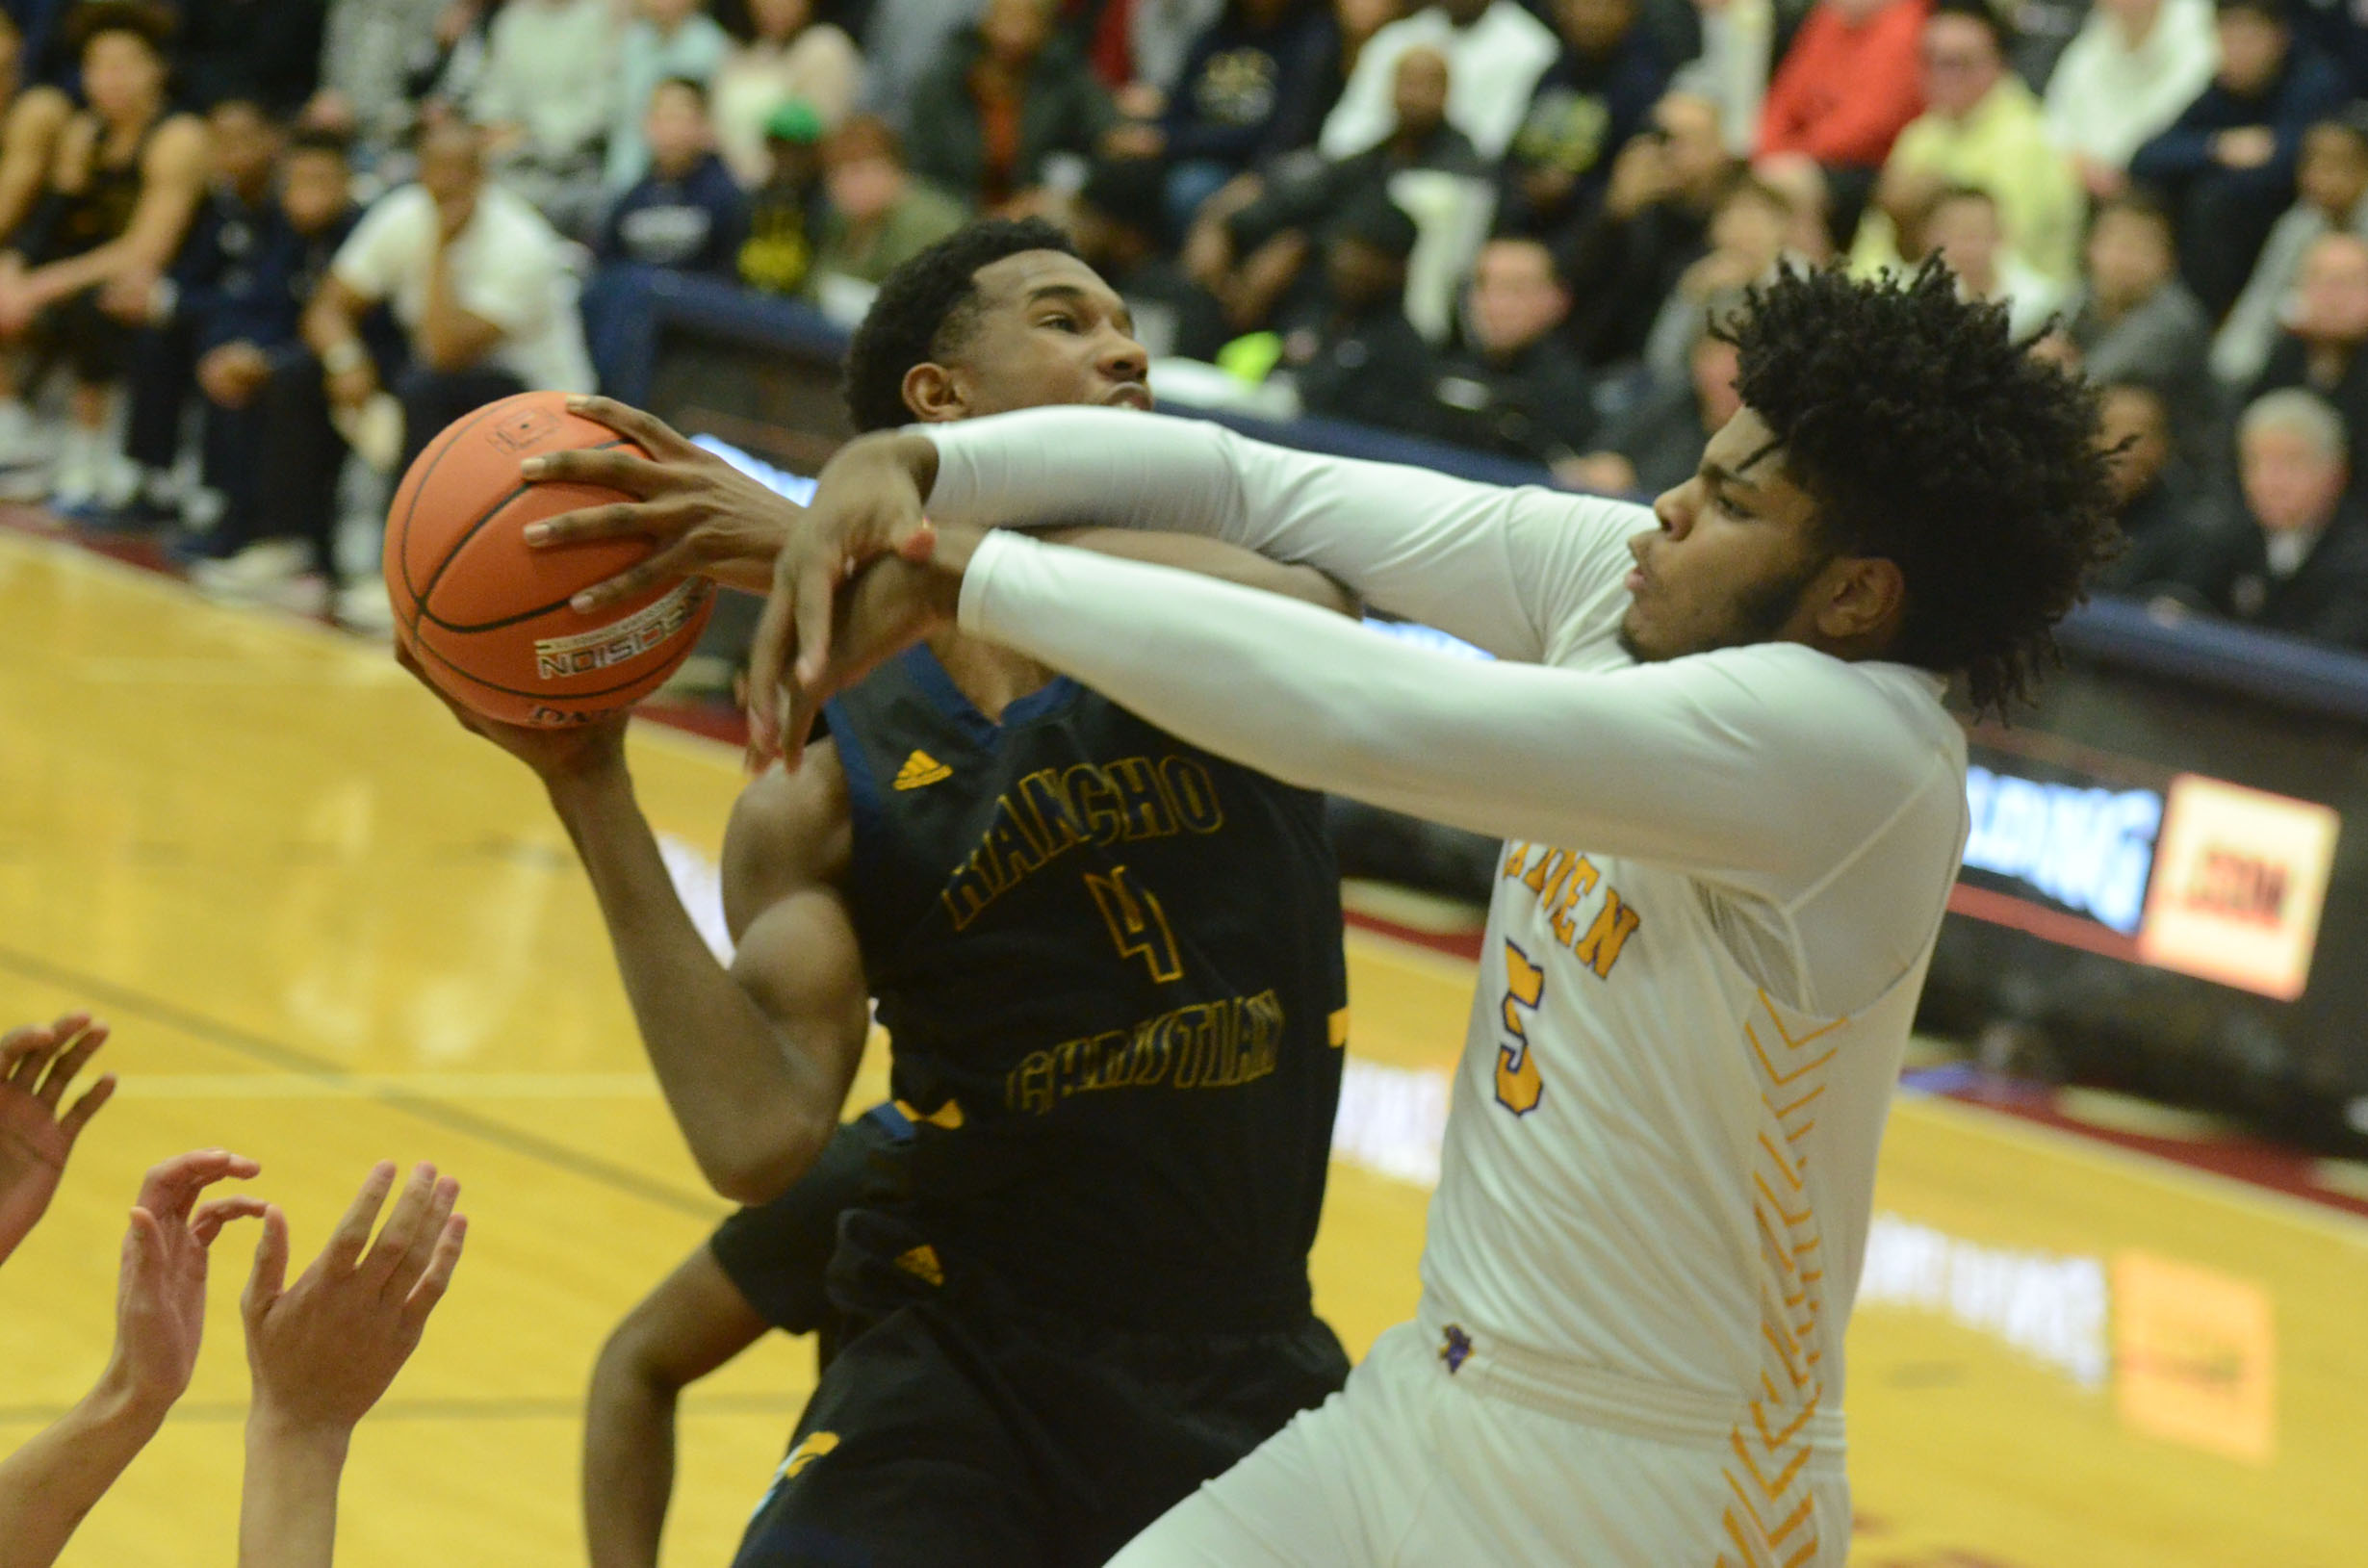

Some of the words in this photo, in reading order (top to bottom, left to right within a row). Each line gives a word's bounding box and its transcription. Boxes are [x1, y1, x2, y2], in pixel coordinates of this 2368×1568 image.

[940, 755, 1223, 931] RANCHO
[1084, 864, 1184, 985] 4
[1494, 937, 1545, 1118] 5
